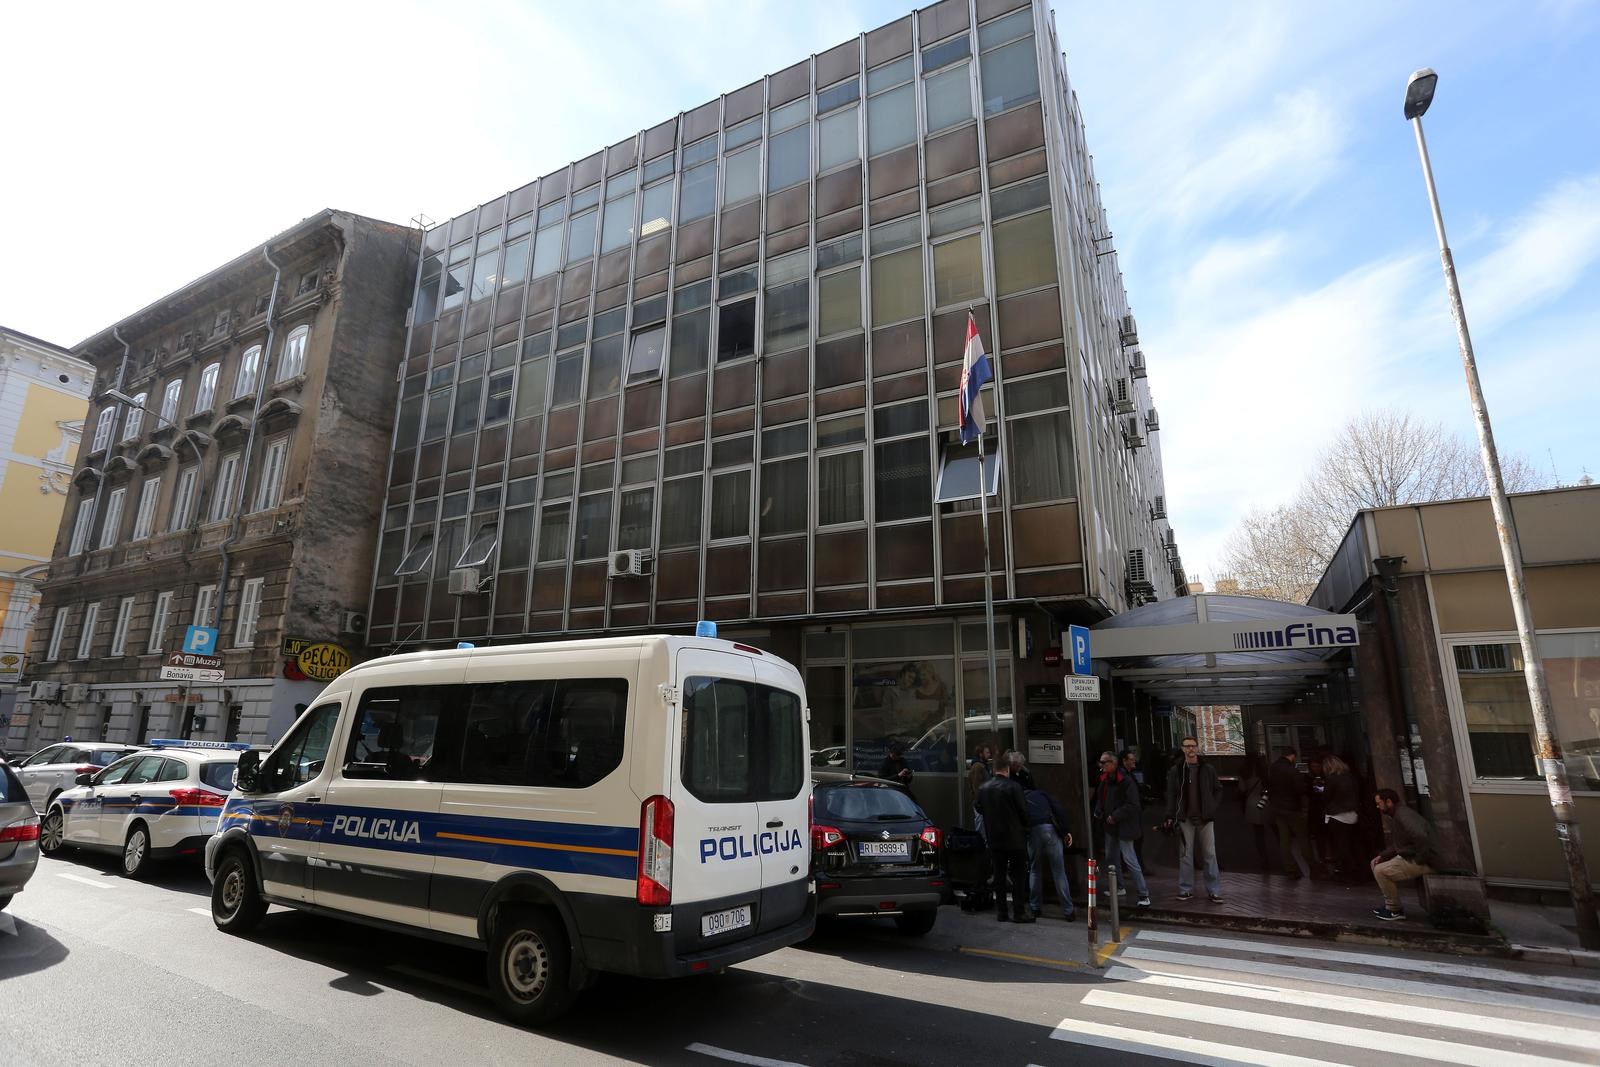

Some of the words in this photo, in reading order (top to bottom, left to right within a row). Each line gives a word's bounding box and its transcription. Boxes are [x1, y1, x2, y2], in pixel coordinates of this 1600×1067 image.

[190, 629, 210, 650] P
[1285, 623, 1357, 647] Fina
[195, 656, 222, 667] Muzeji
[166, 670, 194, 680] Bonavia
[1043, 743, 1062, 751] Fina
[331, 815, 421, 844] POLICIJA
[708, 824, 743, 832] TRANSIT
[700, 829, 803, 864] POLICIJA
[864, 844, 874, 853] RI
[708, 913, 725, 930] 090
[730, 908, 745, 925] 706
